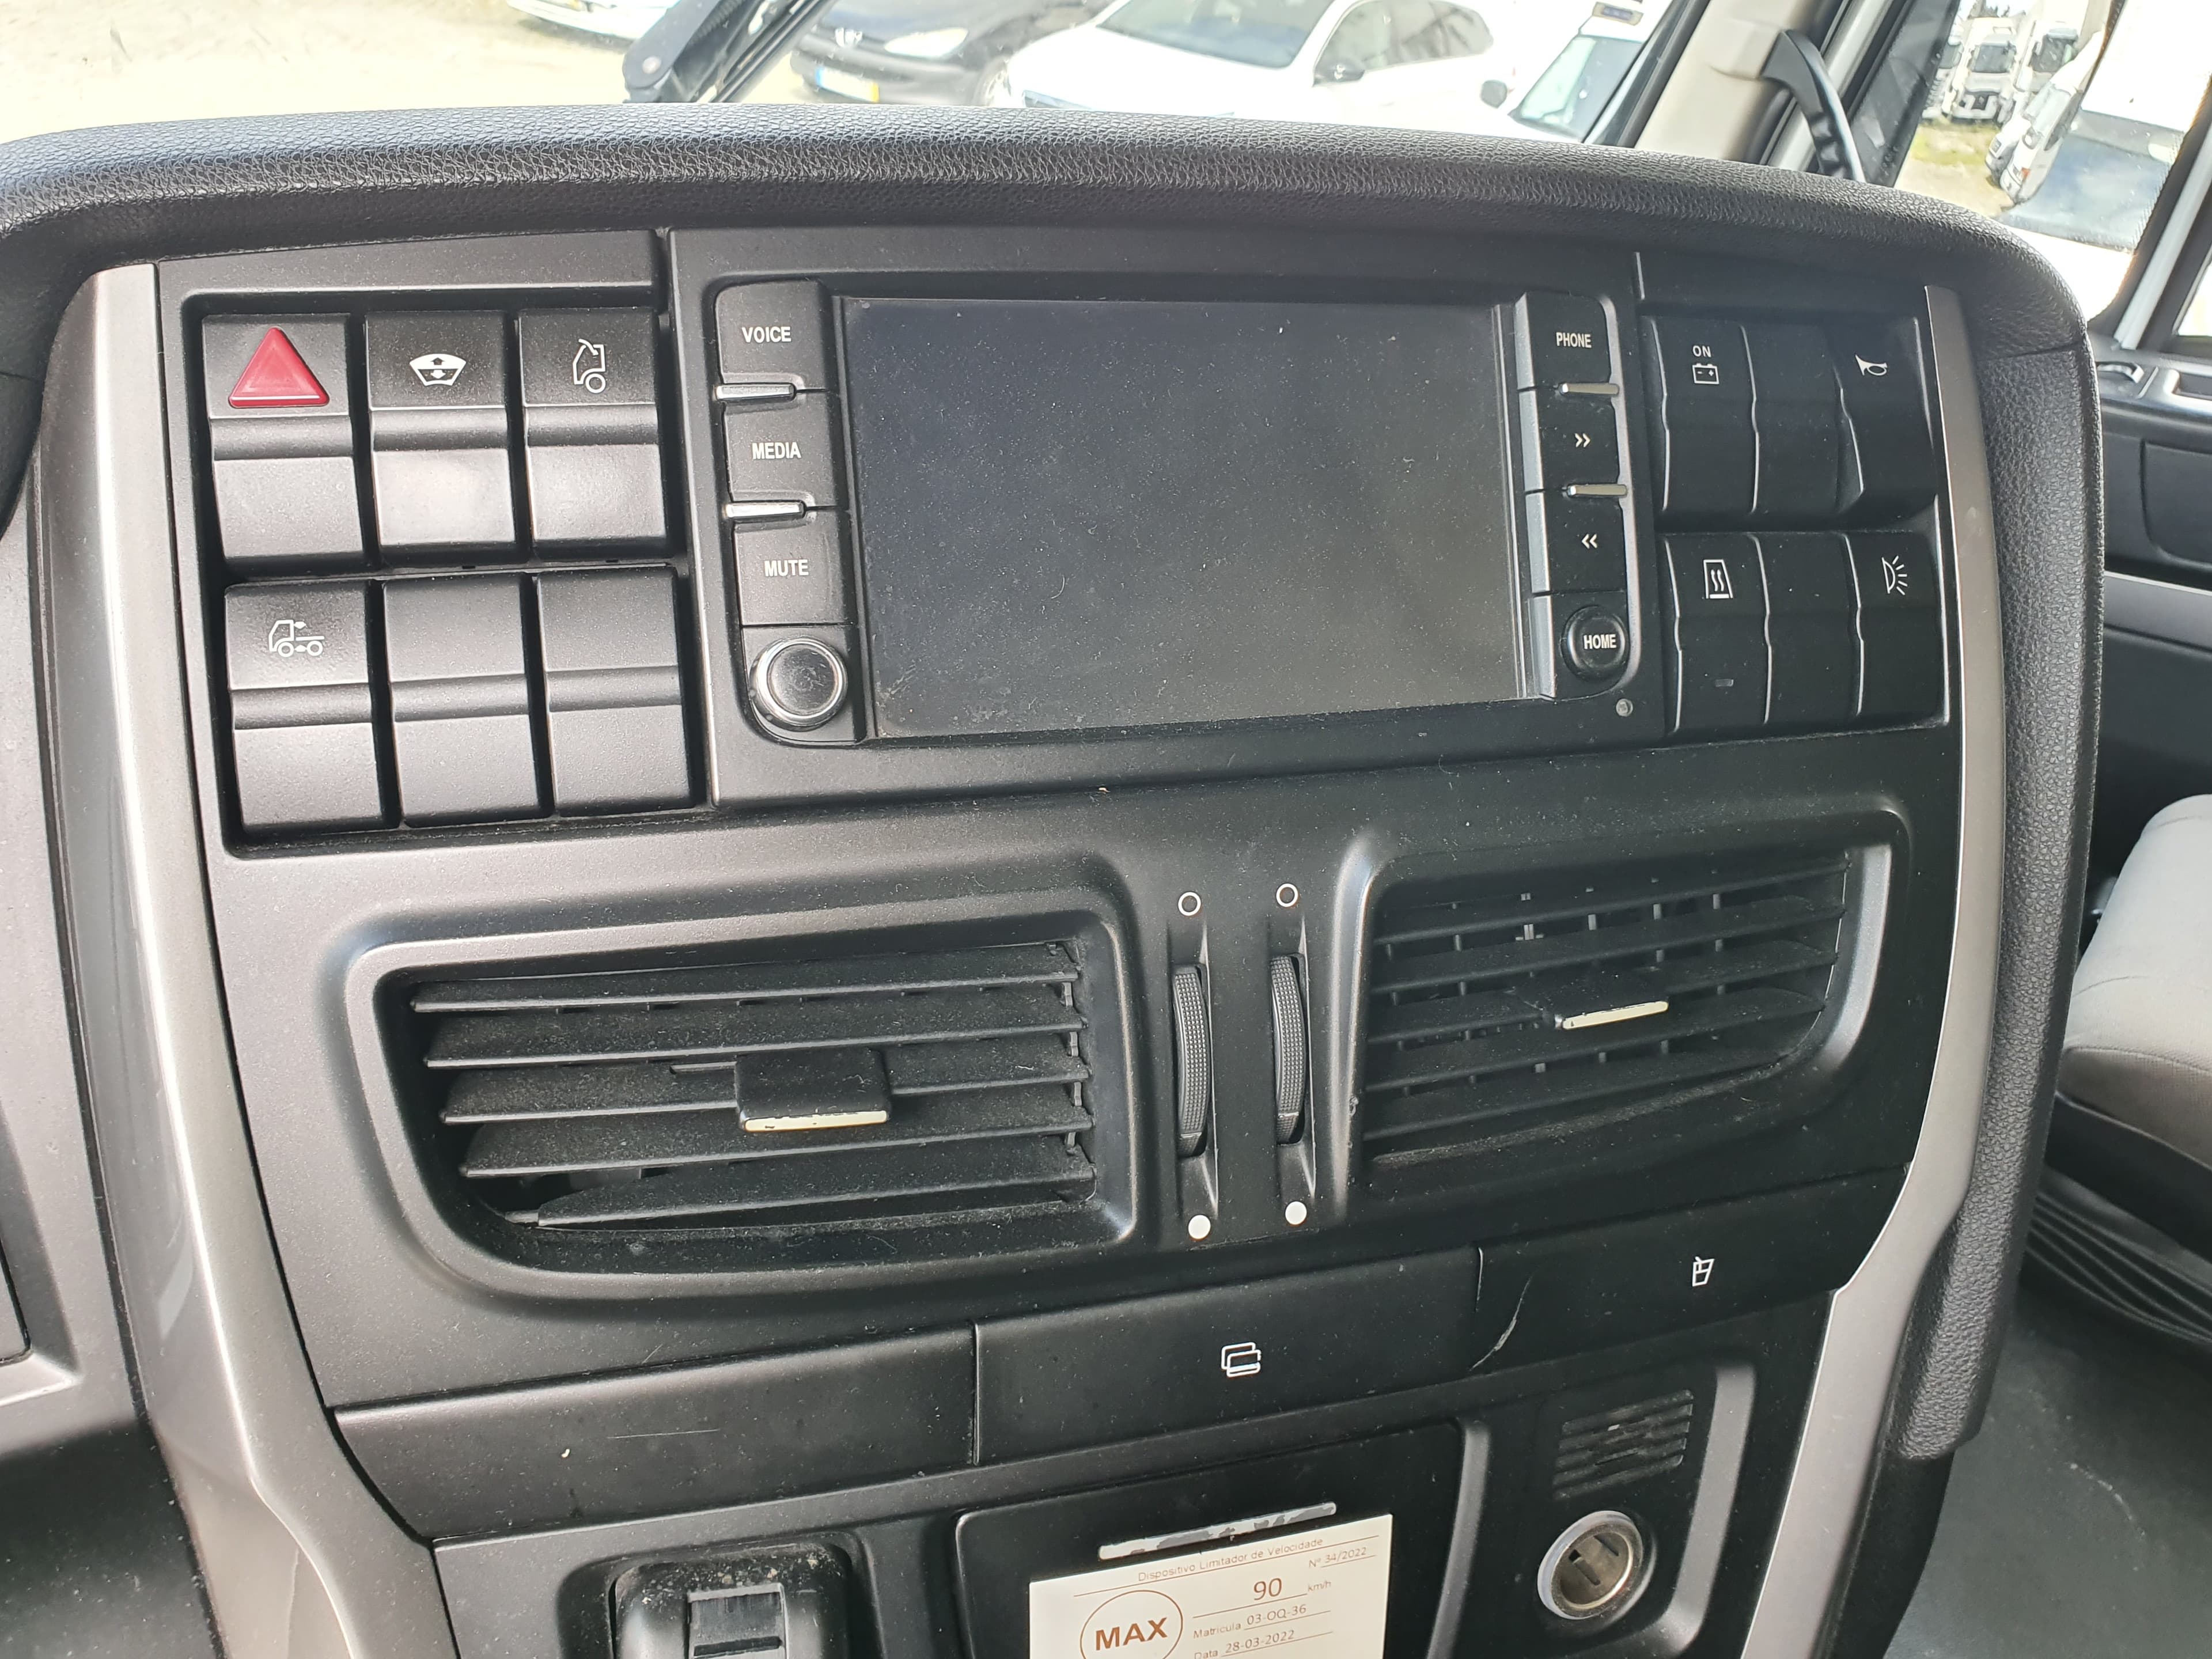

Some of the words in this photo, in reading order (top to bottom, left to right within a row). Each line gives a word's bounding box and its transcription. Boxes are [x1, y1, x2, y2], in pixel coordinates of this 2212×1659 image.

[741, 326, 791, 343] VOICE
[1555, 331, 1592, 348] PHONE
[1692, 345, 1712, 358] ON
[752, 442, 801, 460] MEDIA
[764, 559, 809, 577] MUTE
[1583, 634, 1617, 650] HOME
[1138, 1563, 1196, 1582] Dispositivo
[1199, 1553, 1248, 1570] Limitador
[1251, 1549, 1264, 1560] de
[1267, 1538, 1323, 1556] Velocidade
[1324, 1547, 1367, 1563] 34/2022
[1253, 1577, 1282, 1601] 90
[1307, 1579, 1332, 1592] km/h
[1247, 1604, 1306, 1626] 03-OQ-36
[1096, 1617, 1168, 1651] MAX
[1194, 1649, 1218, 1659] Data
[1225, 1630, 1294, 1654] 28-03-2022
